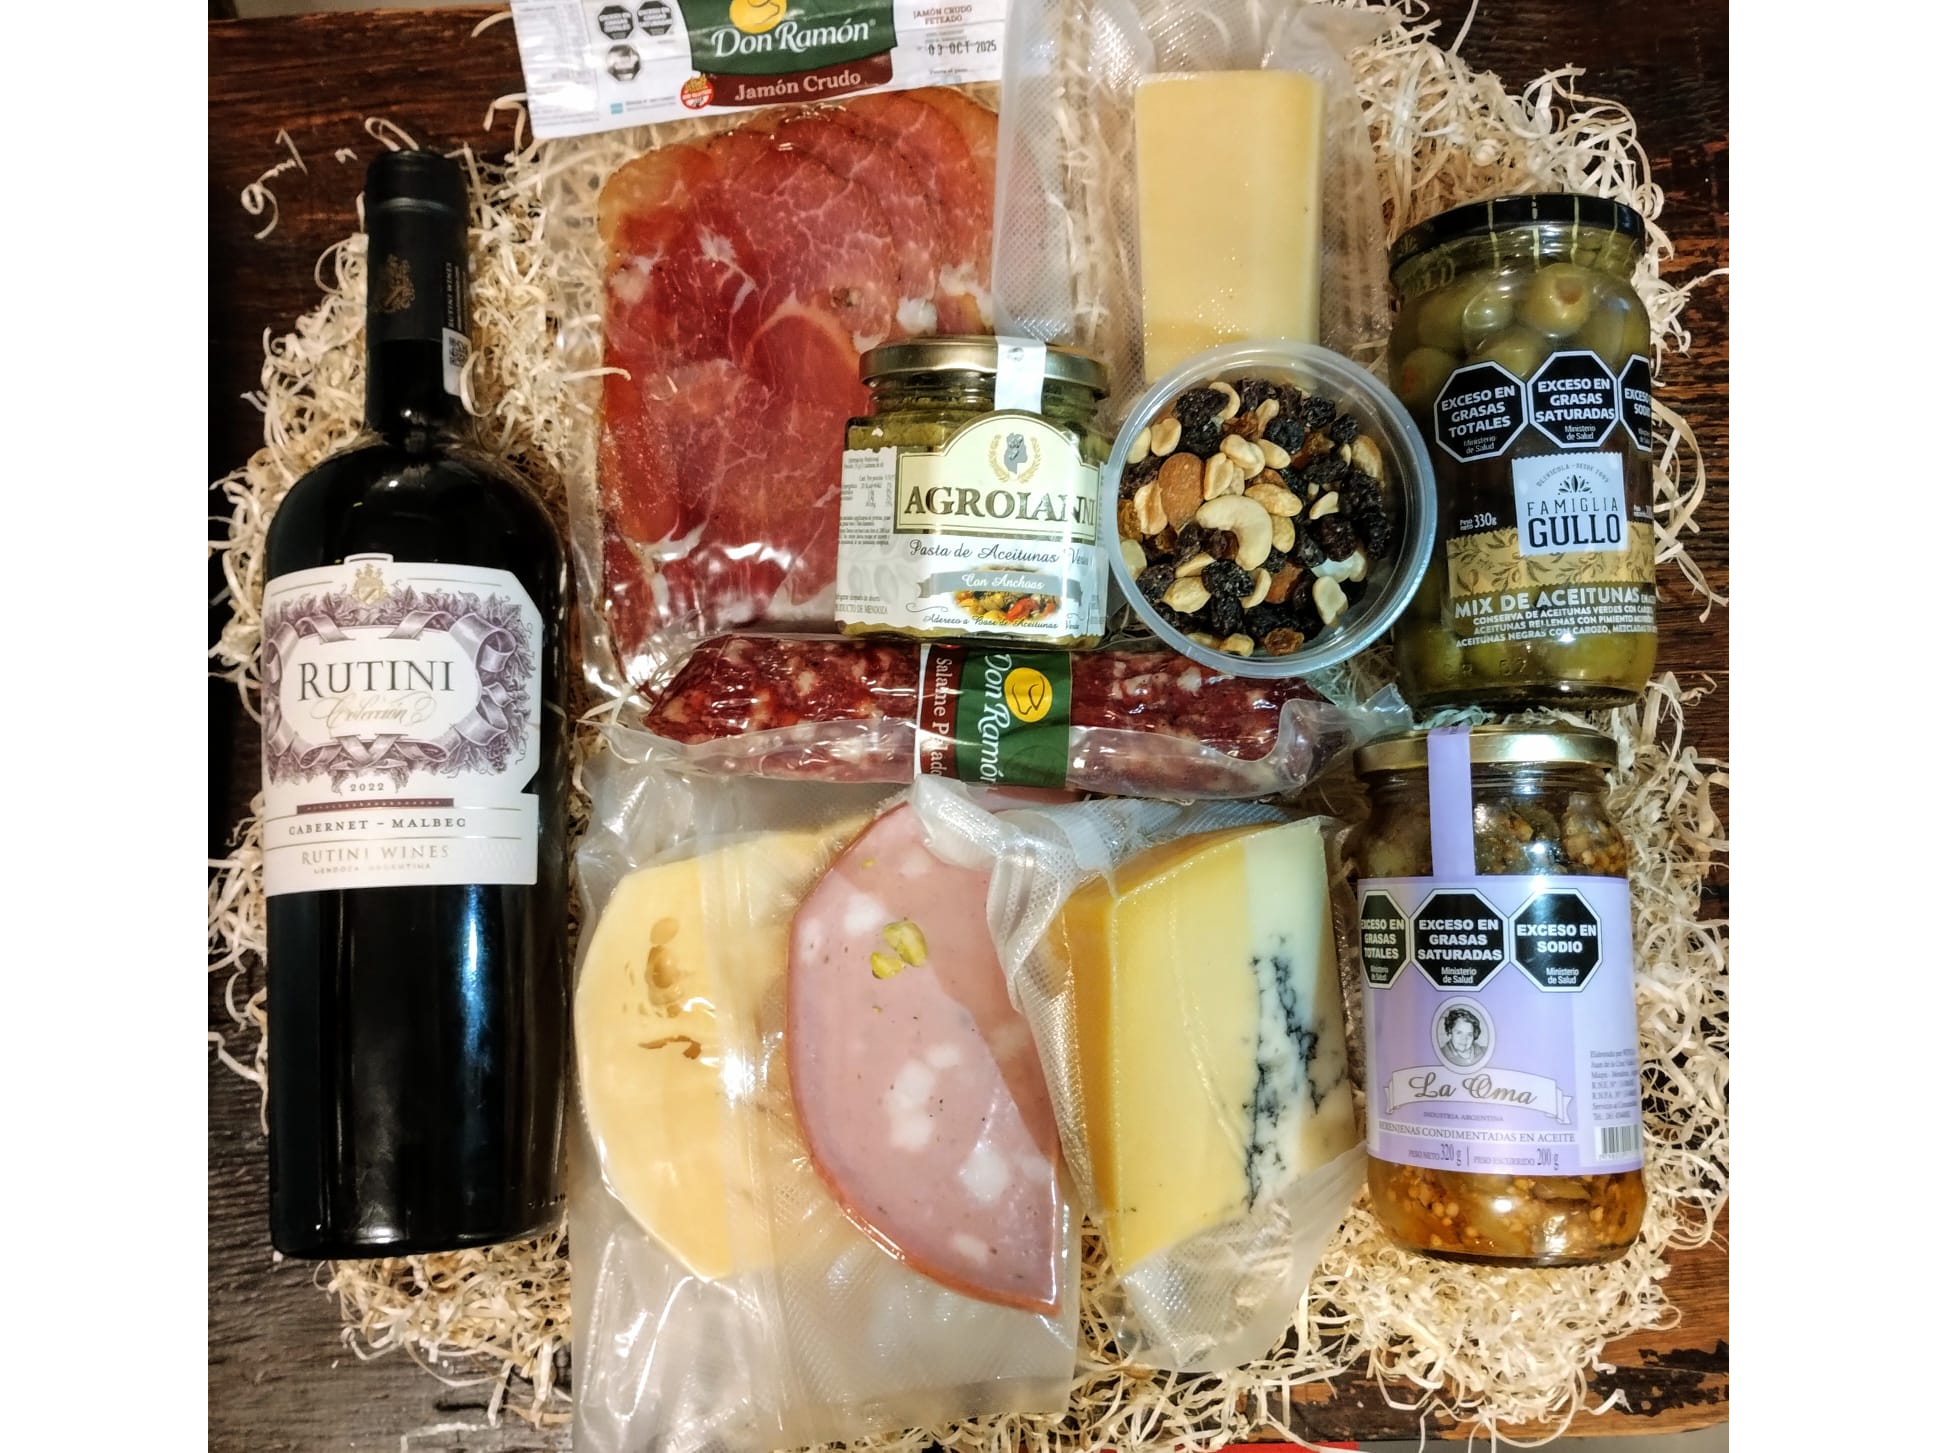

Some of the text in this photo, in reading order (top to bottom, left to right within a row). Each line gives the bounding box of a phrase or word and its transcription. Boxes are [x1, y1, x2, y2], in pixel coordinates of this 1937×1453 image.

[943, 4, 973, 15] CRUDO
[924, 14, 963, 25] FETEADO
[711, 18, 870, 58] Don Ramón
[948, 40, 969, 54] OCT
[975, 39, 997, 53] 2025
[735, 79, 800, 101] Jamón
[803, 69, 862, 93] Crudo
[1538, 378, 1611, 393] EXCESO EN
[1441, 384, 1516, 412] EXCESO EN
[1549, 393, 1604, 407] GRASAS
[1451, 401, 1506, 423] GRASAS
[1535, 407, 1616, 423] SATURADAS
[1448, 415, 1512, 439] TOTALES
[1564, 424, 1596, 433] Ministerio
[1463, 435, 1496, 447] Ministerio
[1576, 431, 1594, 440] Salud
[1465, 442, 1495, 455] de Salud
[1527, 497, 1620, 517] FAMIGLIA
[1528, 513, 1622, 548] GULLO
[909, 539, 951, 557] Pasta
[953, 542, 973, 559] de
[978, 543, 1060, 564] Aceitunas
[961, 573, 1045, 591] Con Anchoas
[1454, 596, 1494, 618] MIX
[1500, 592, 1530, 612] DE
[1535, 586, 1640, 609] ACEITUNAS
[1473, 612, 1524, 626] CONSERVA
[1525, 610, 1539, 619] DE
[1540, 605, 1592, 618] ACEITUNAS
[1592, 605, 1623, 614] VERDES
[1474, 621, 1527, 635] ACEITUNAS
[1529, 617, 1575, 629] RELLENAS
[1577, 616, 1597, 625] CON
[1598, 615, 1634, 624] PIMIENTO
[1456, 634, 1506, 648] ACEITUNAS
[1508, 629, 1546, 642] NEGRAS
[297, 660, 456, 703] RUTINI
[985, 653, 1012, 700] Don
[933, 657, 953, 718] Salame
[349, 782, 386, 793] 2022
[288, 820, 370, 836] CABERNET
[391, 817, 467, 829] MALBEC
[301, 844, 450, 866] RUTINI WINES
[1389, 919, 1405, 931] EN
[1418, 919, 1500, 931] EXCESO EN
[1516, 924, 1598, 937] EXCESO EN
[1364, 933, 1397, 945] GRASAS
[1429, 934, 1488, 946] GRASAS
[1364, 948, 1400, 960] TOTALES
[1537, 941, 1584, 953] SODIO
[1417, 949, 1503, 961] SATURADAS
[1441, 966, 1478, 976] Ministerio
[1546, 966, 1580, 977] Ministerio
[1442, 975, 1474, 984] de Salud
[1547, 975, 1577, 985] de Salud
[1408, 1071, 1538, 1105] La Oma
[1423, 1111, 1505, 1122] INDUSTRIA ARGENTINA
[1421, 1127, 1517, 1143] CONDIMENTADAS
[1519, 1133, 1535, 1142] EN
[1537, 1132, 1576, 1143] ACEITE
[1408, 1149, 1425, 1158] PESO
[1424, 1150, 1441, 1161] NETO
[1440, 1143, 1455, 1162] 320
[1473, 1155, 1492, 1165] PESO
[1537, 1147, 1552, 1166] 200
